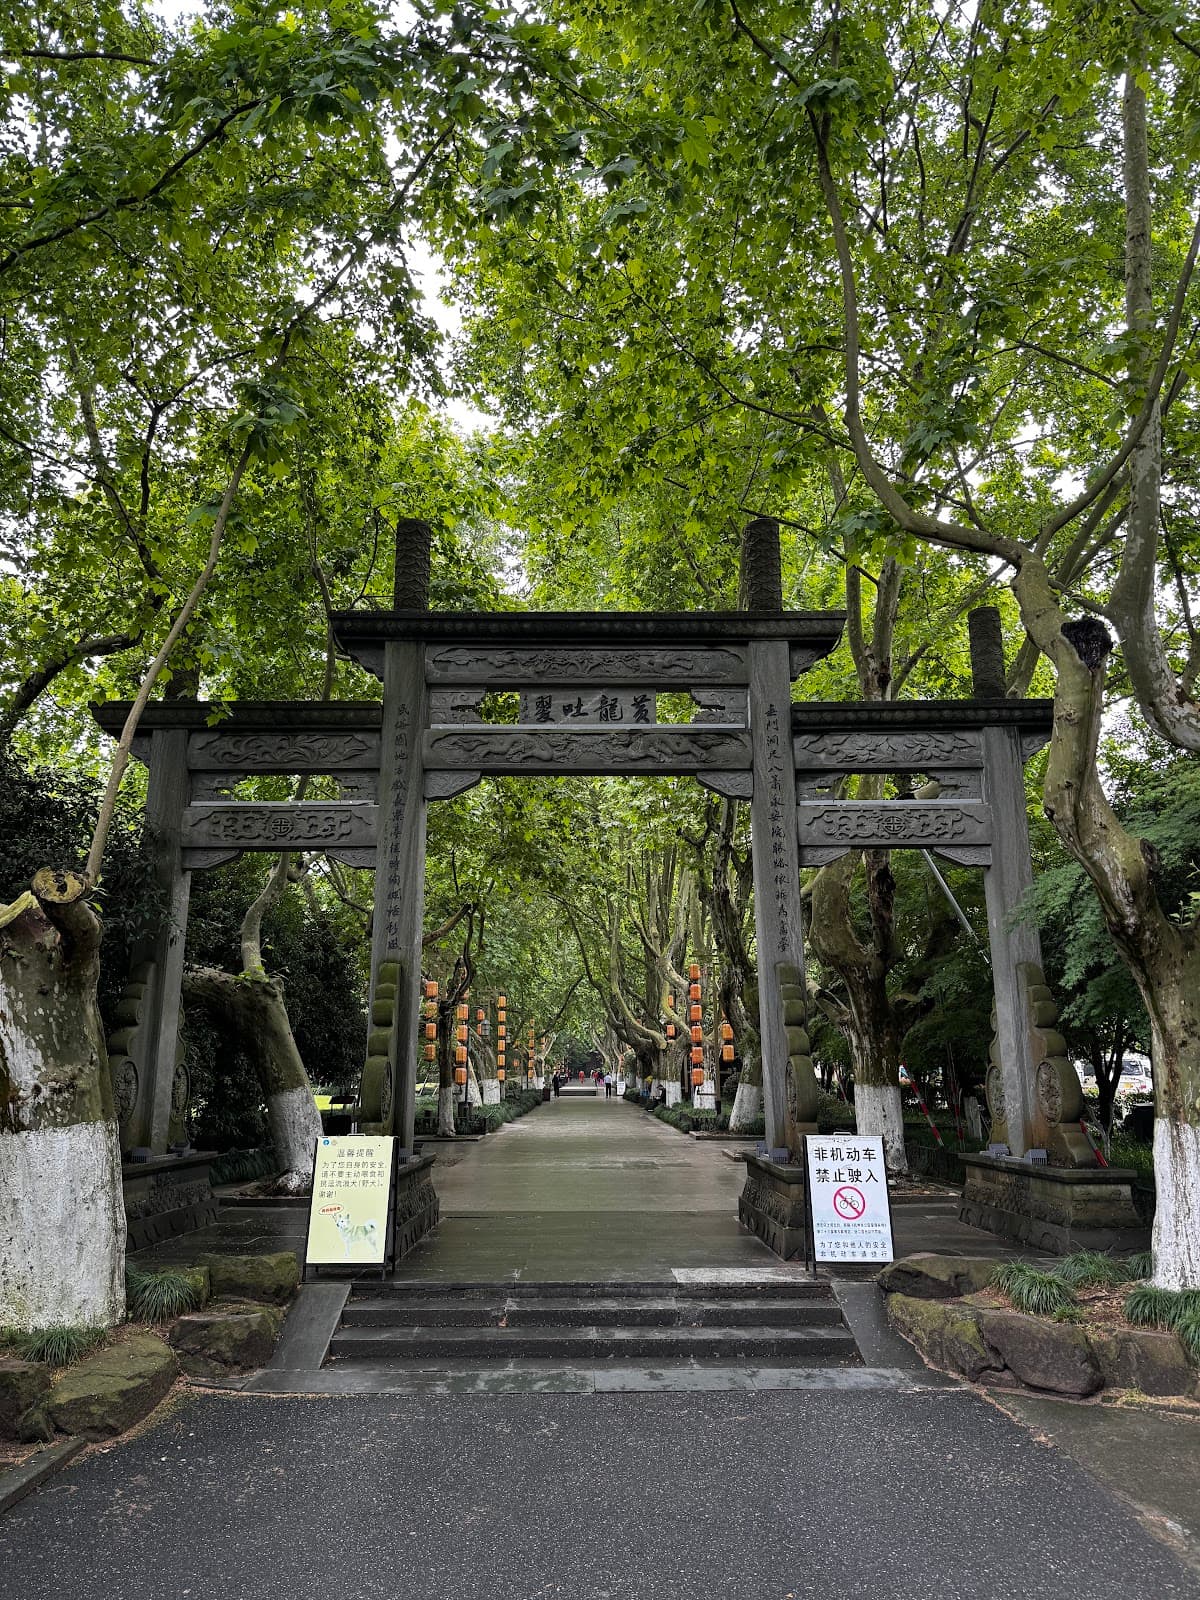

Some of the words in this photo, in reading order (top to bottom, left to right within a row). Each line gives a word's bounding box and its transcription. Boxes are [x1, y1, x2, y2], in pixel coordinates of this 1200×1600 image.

[337, 1148, 375, 1158] 温馨提醒
[814, 1147, 876, 1162] 非机动车
[815, 1168, 879, 1183] 禁止驶入
